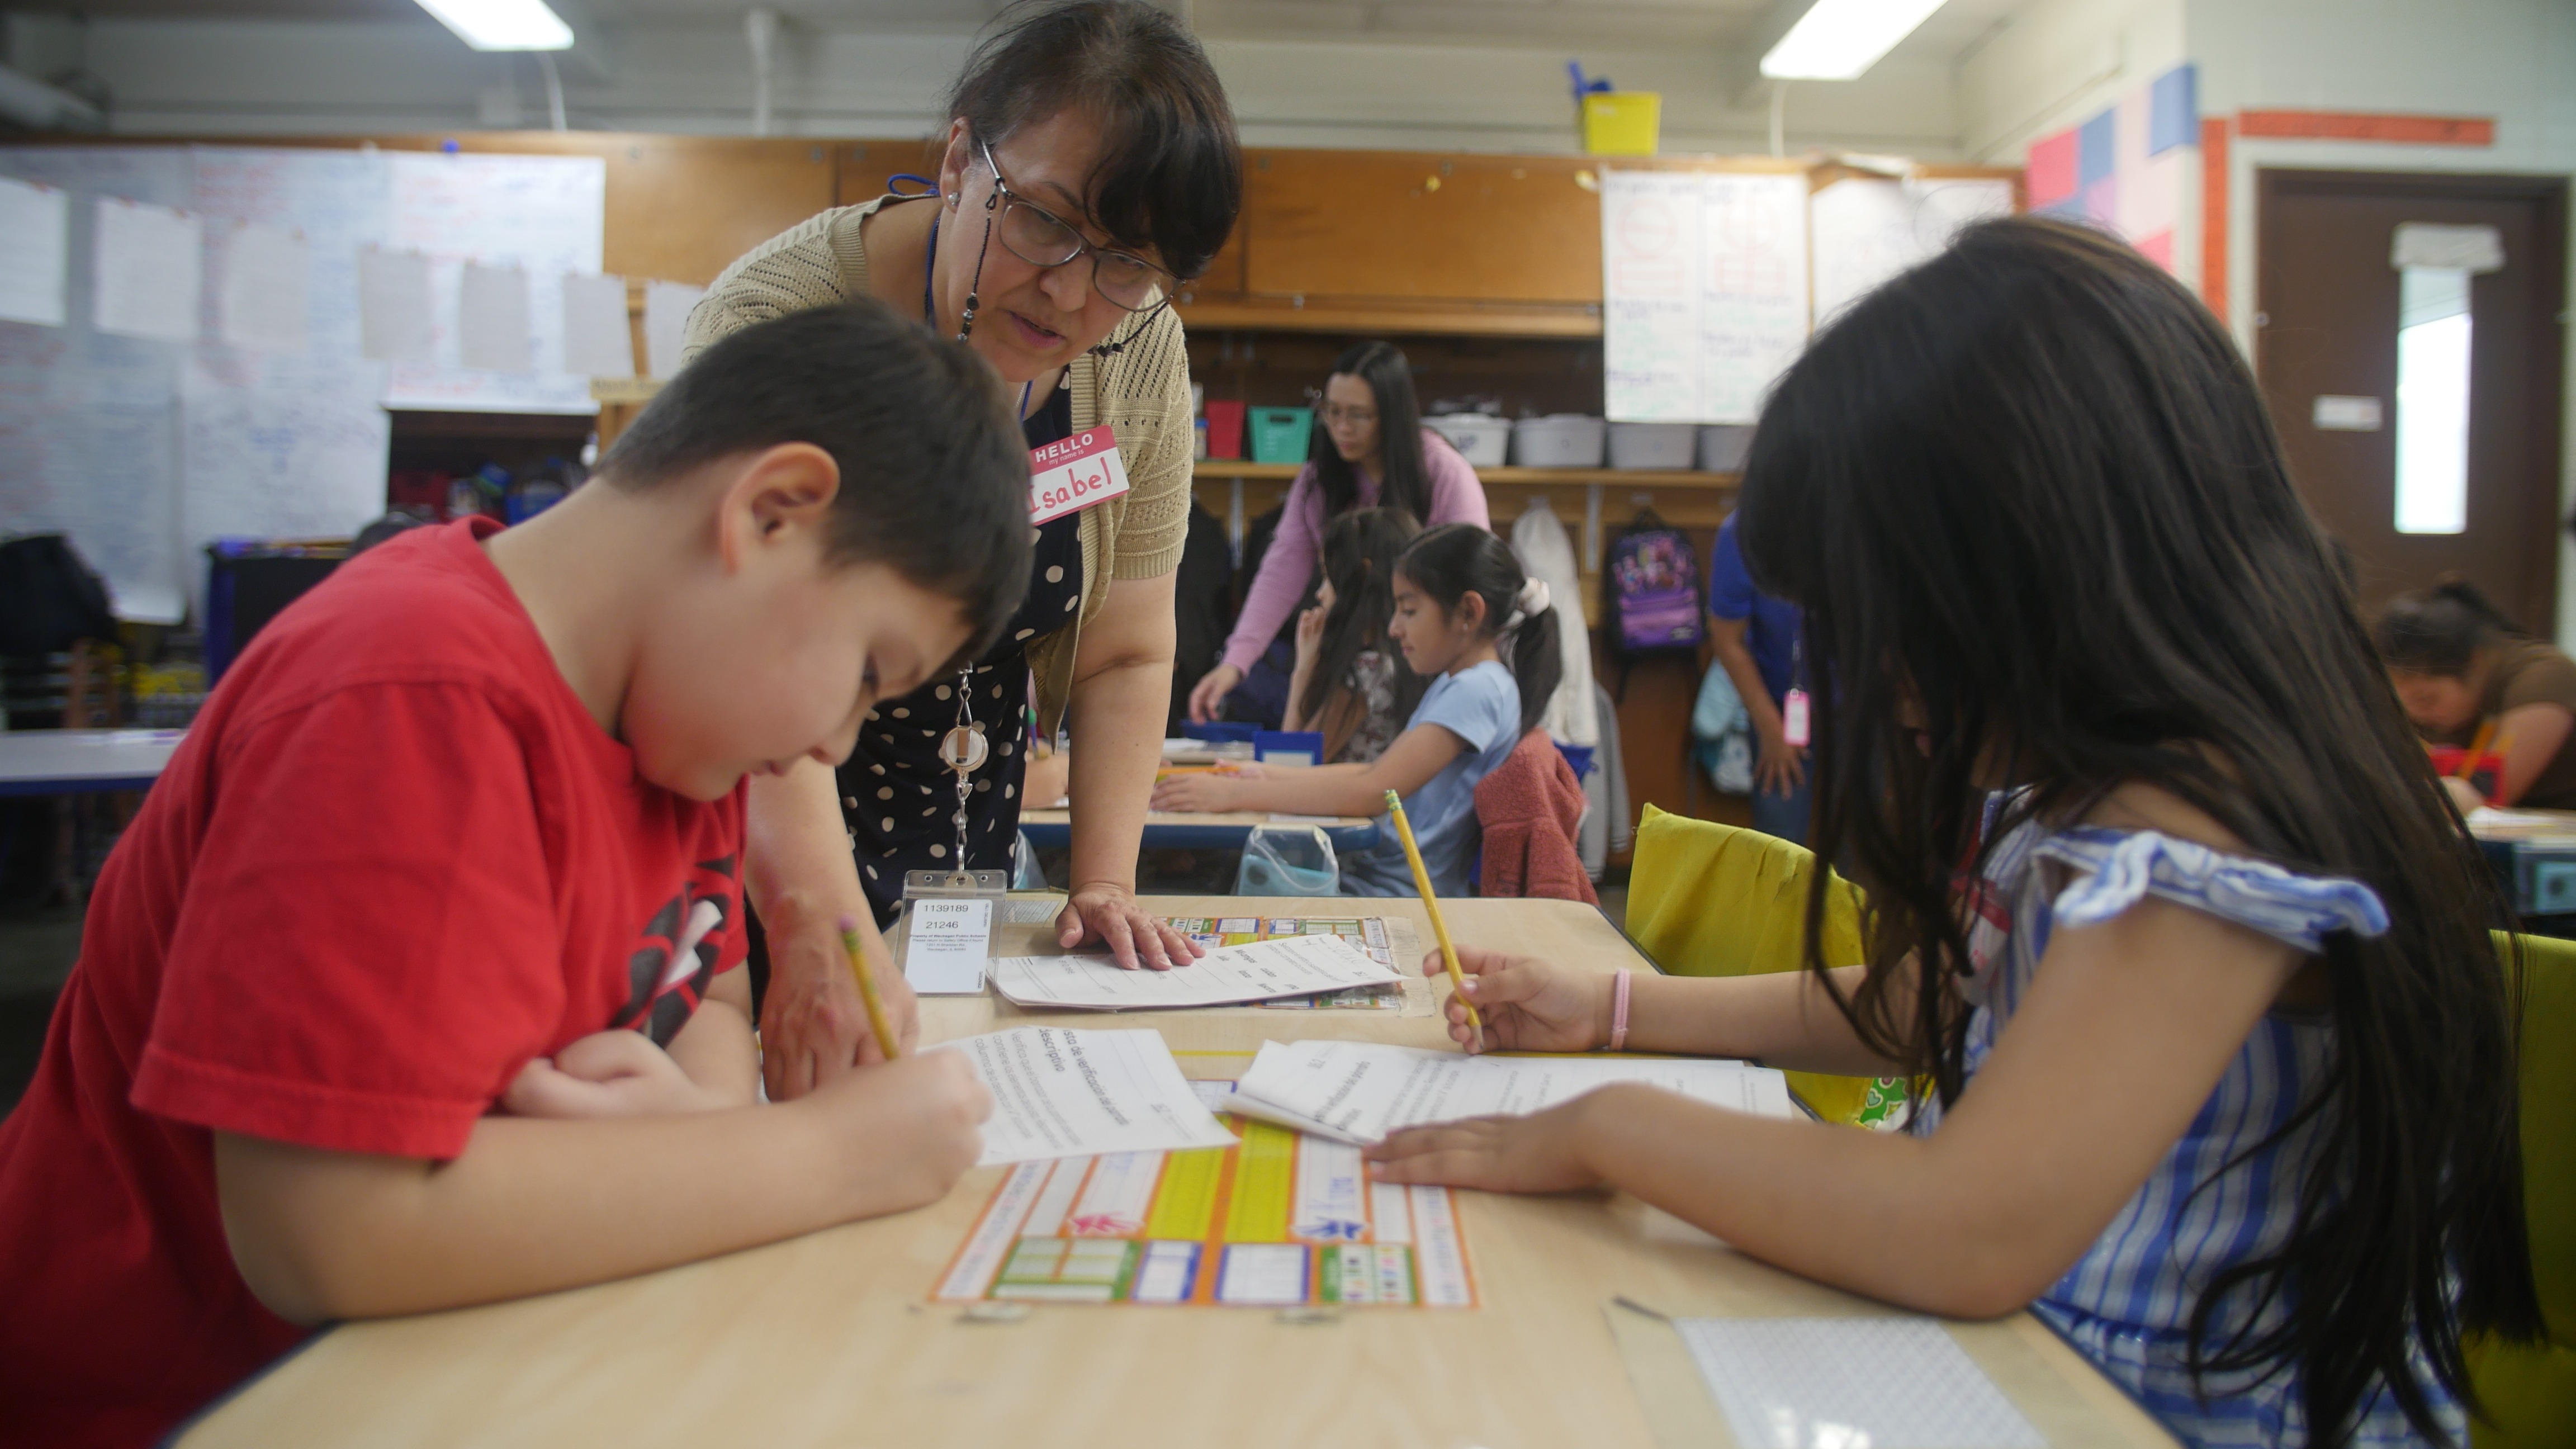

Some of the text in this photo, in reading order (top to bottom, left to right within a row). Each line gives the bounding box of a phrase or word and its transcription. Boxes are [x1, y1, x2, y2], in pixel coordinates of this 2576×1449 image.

[1036, 434, 1093, 462] HELLO
[1060, 452, 1077, 461] name
[1029, 457, 1112, 514] Isabel
[975, 1038, 992, 1067] columna
[993, 1035, 1010, 1064] contiene
[1011, 1030, 1027, 1059] Verifica
[1063, 1029, 1077, 1045] ista
[1071, 1046, 1086, 1057] de
